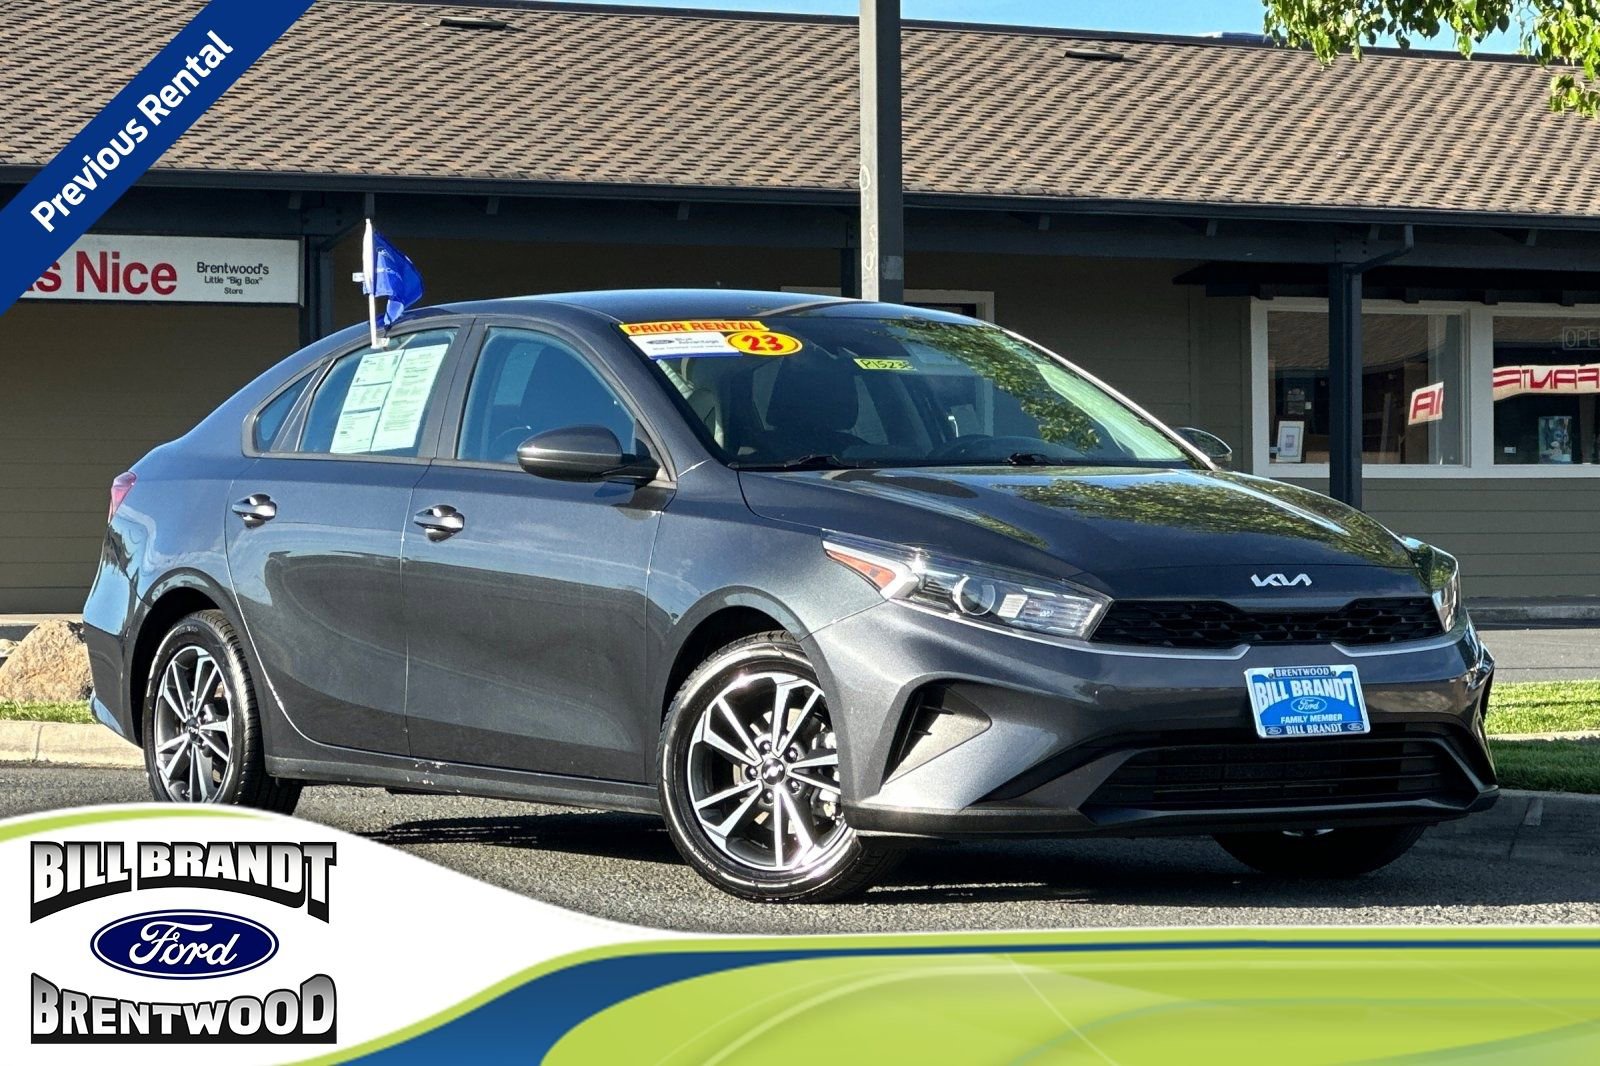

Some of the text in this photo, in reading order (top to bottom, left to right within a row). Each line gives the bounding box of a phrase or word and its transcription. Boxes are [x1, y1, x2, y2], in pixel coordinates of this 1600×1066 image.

[28, 251, 178, 295] s Nice
[197, 262, 269, 275] Brentwood's
[204, 276, 224, 284] Little
[224, 287, 243, 295] Store
[629, 320, 763, 333] PRIOR RENTAL
[741, 335, 784, 351] 23
[1565, 328, 1600, 348] OPE
[1250, 573, 1313, 587] KIA
[1275, 667, 1330, 677] BRENTWOOD
[1254, 678, 1355, 714] BILL BRANDT
[1297, 697, 1320, 710] Ford
[1280, 713, 1343, 724] FAMILY MEMBER
[1286, 725, 1306, 735] BILL
[1306, 723, 1342, 734] BRANDT
